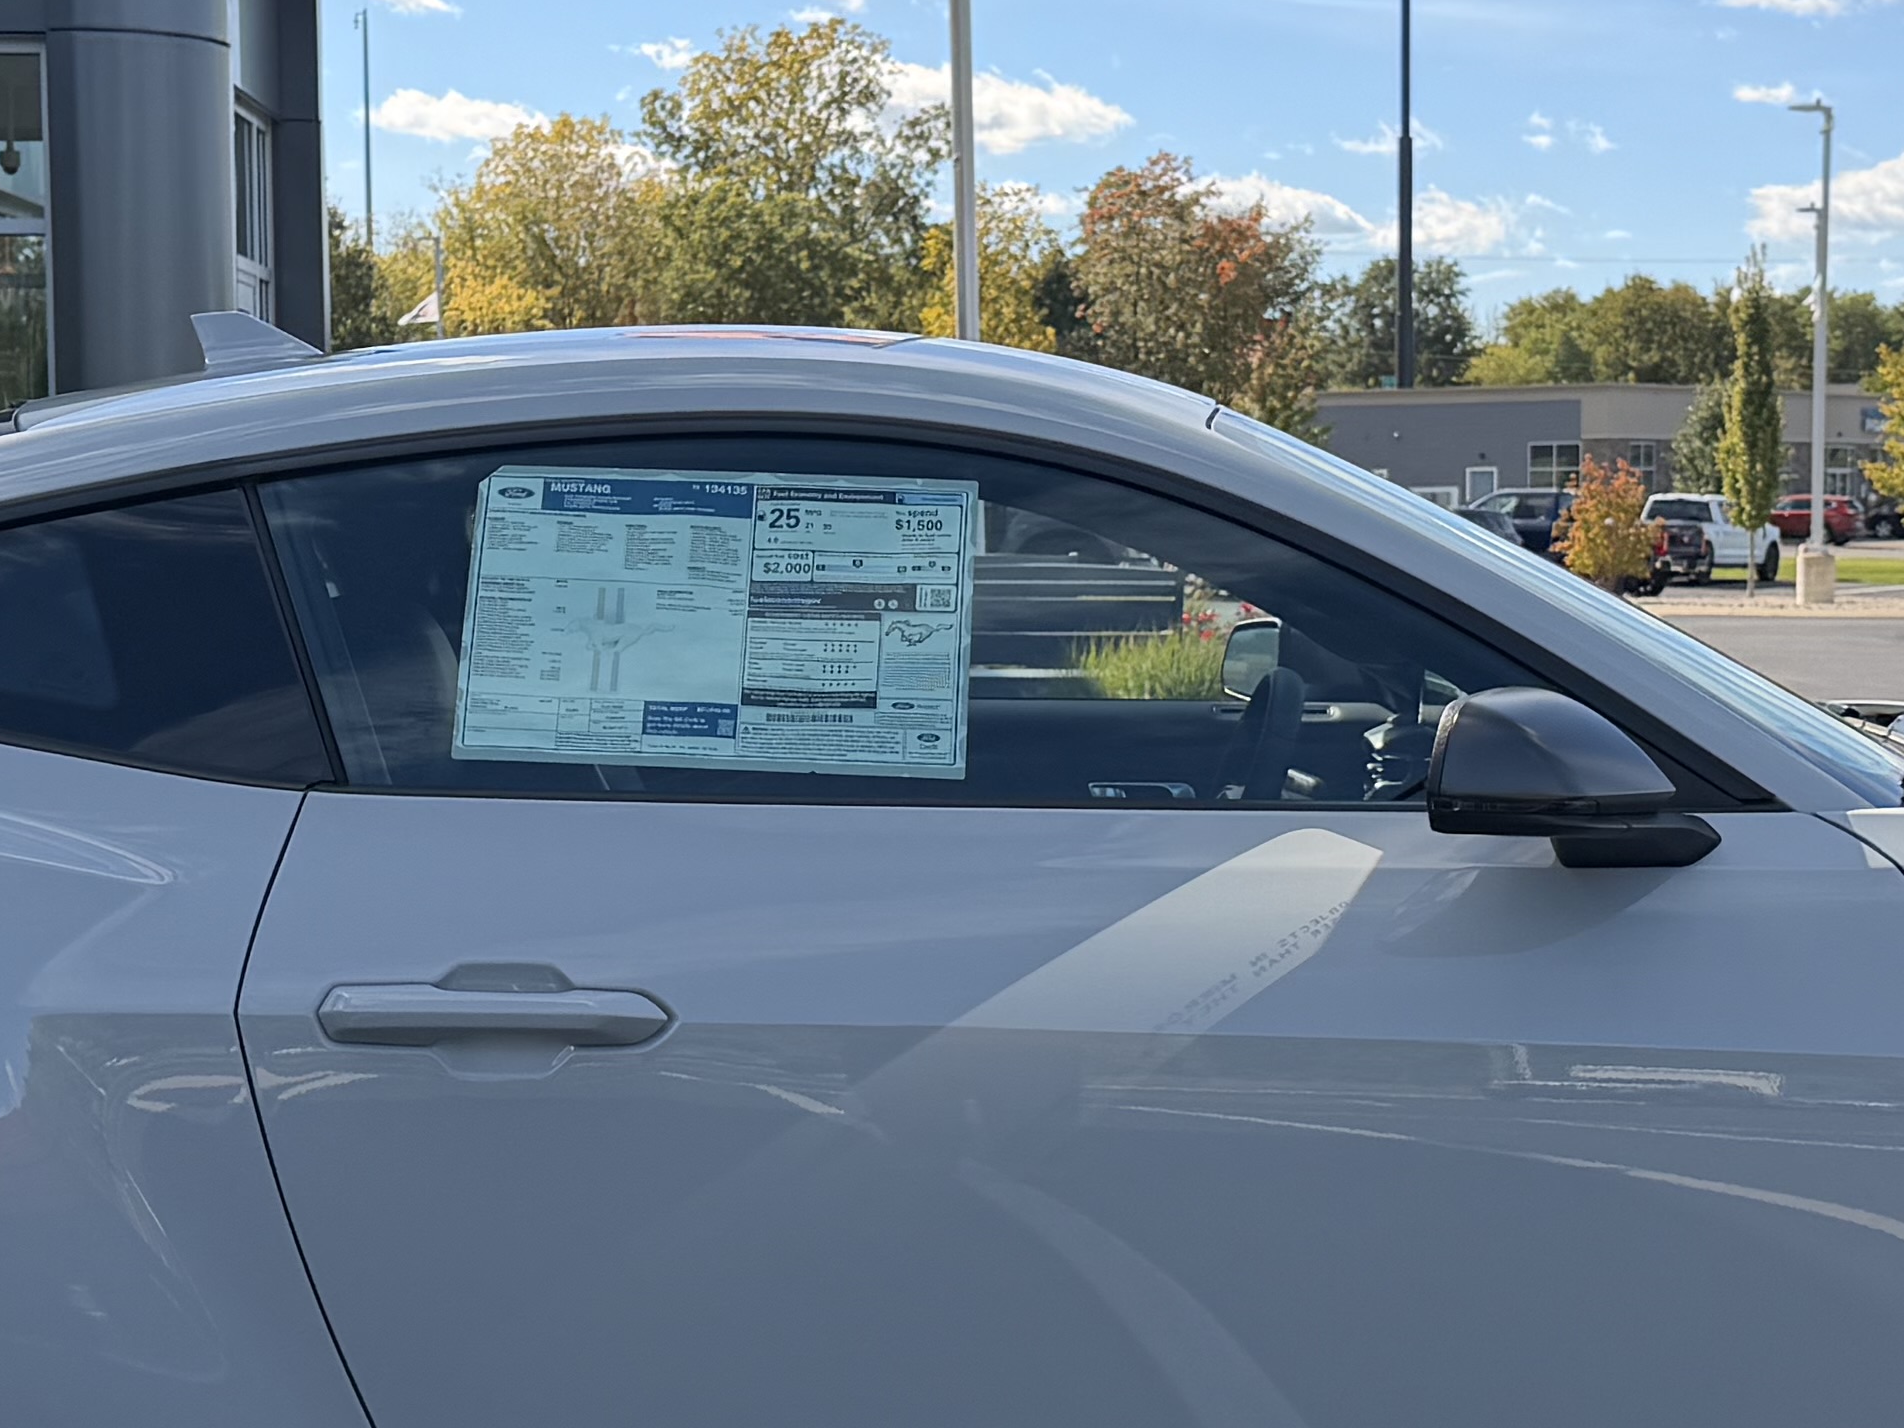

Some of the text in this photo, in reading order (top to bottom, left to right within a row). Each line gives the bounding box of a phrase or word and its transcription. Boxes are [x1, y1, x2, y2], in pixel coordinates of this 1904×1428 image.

[550, 482, 612, 494] MUSTANG
[768, 507, 801, 530] 25
[907, 508, 939, 518] spend
[895, 518, 943, 533] $1,500
[763, 561, 811, 575] $2,000
